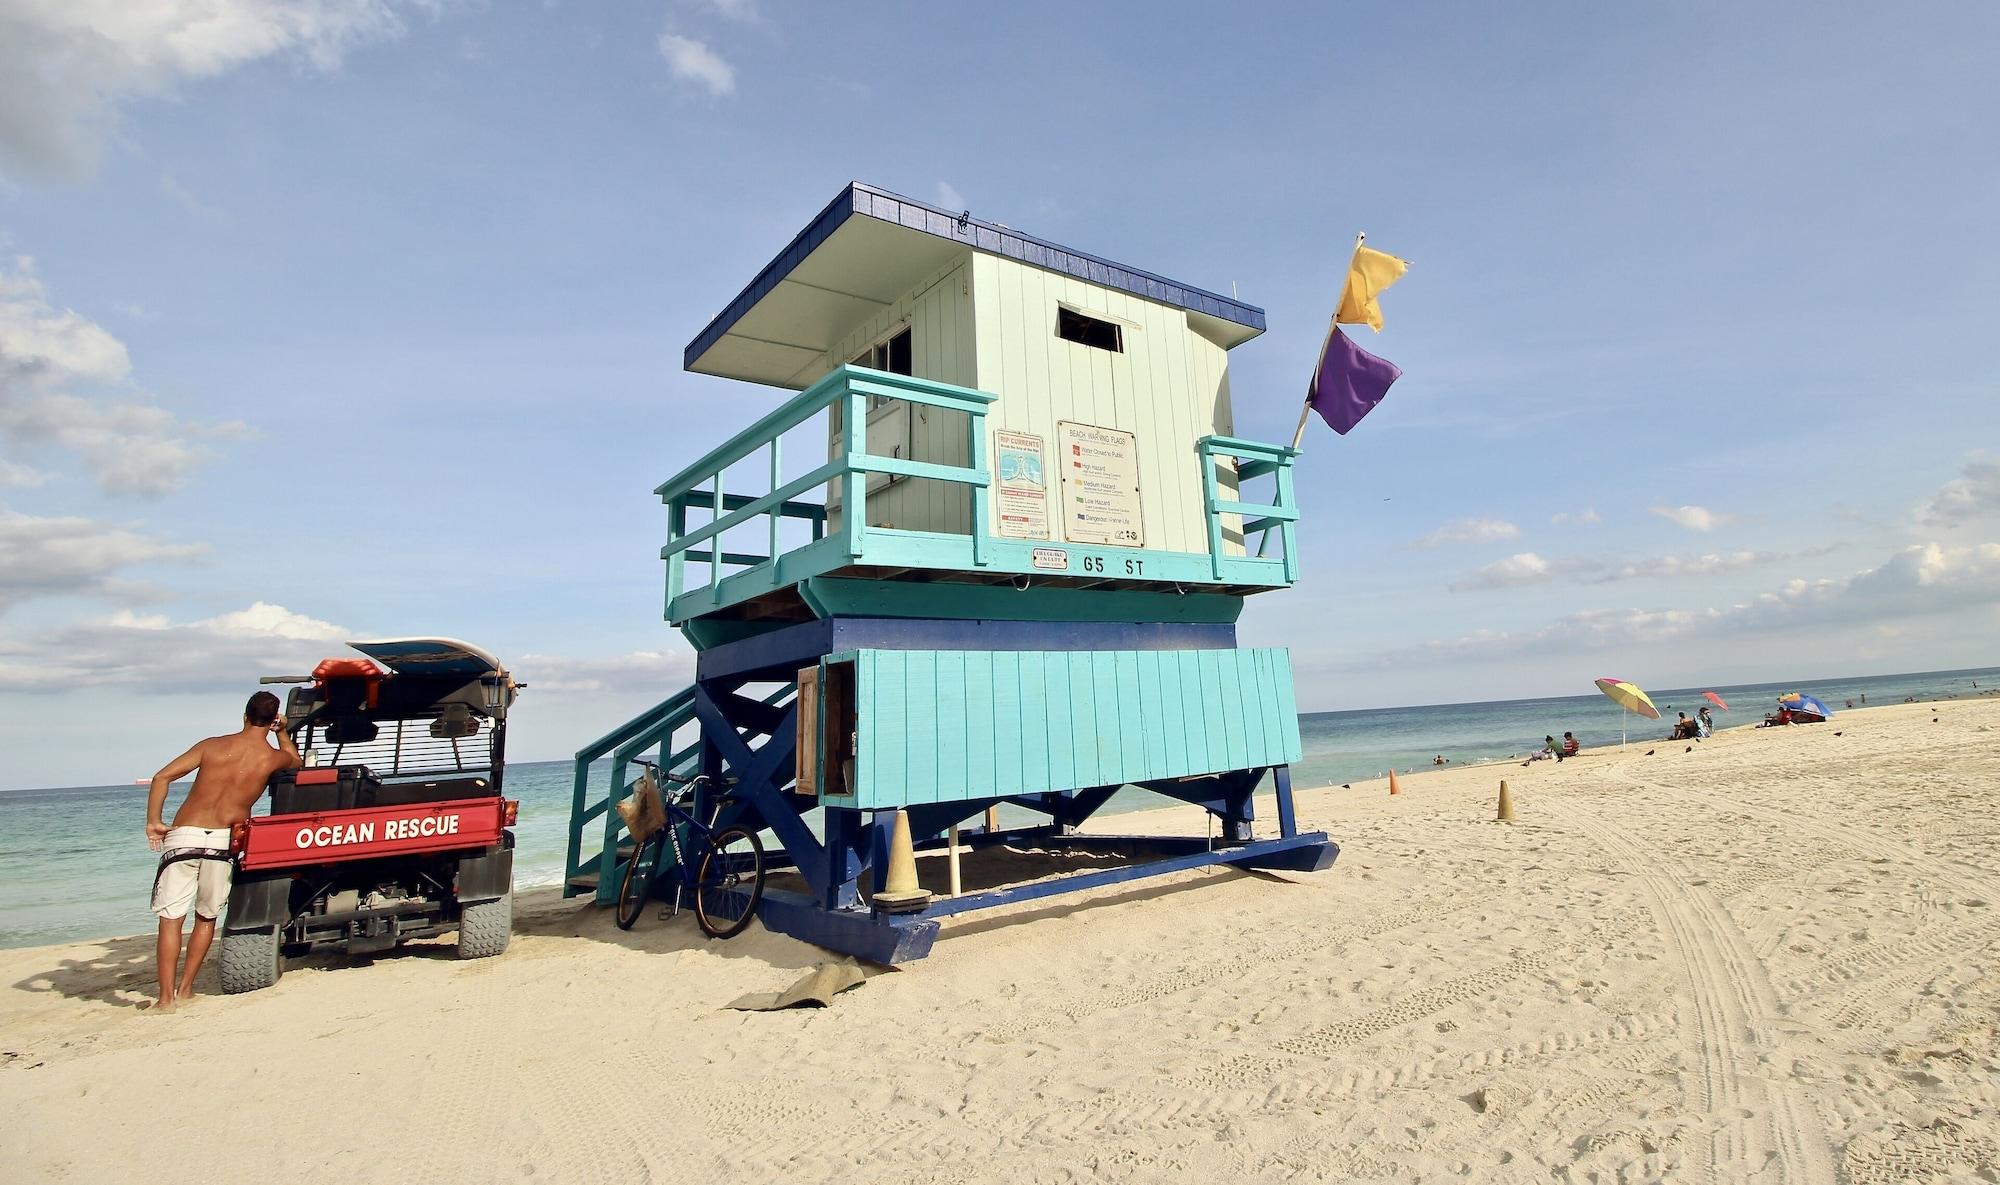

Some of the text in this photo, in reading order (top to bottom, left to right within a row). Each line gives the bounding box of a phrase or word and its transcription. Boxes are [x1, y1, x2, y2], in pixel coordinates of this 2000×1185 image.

[1010, 437, 1040, 448] CURRENTS
[1069, 429, 1086, 439] BEACH
[1110, 435, 1126, 445] FLAGS
[1084, 480, 1100, 488] Medium
[1083, 556, 1143, 576] 65 ST
[295, 814, 460, 849] OCEAN RESCUE
